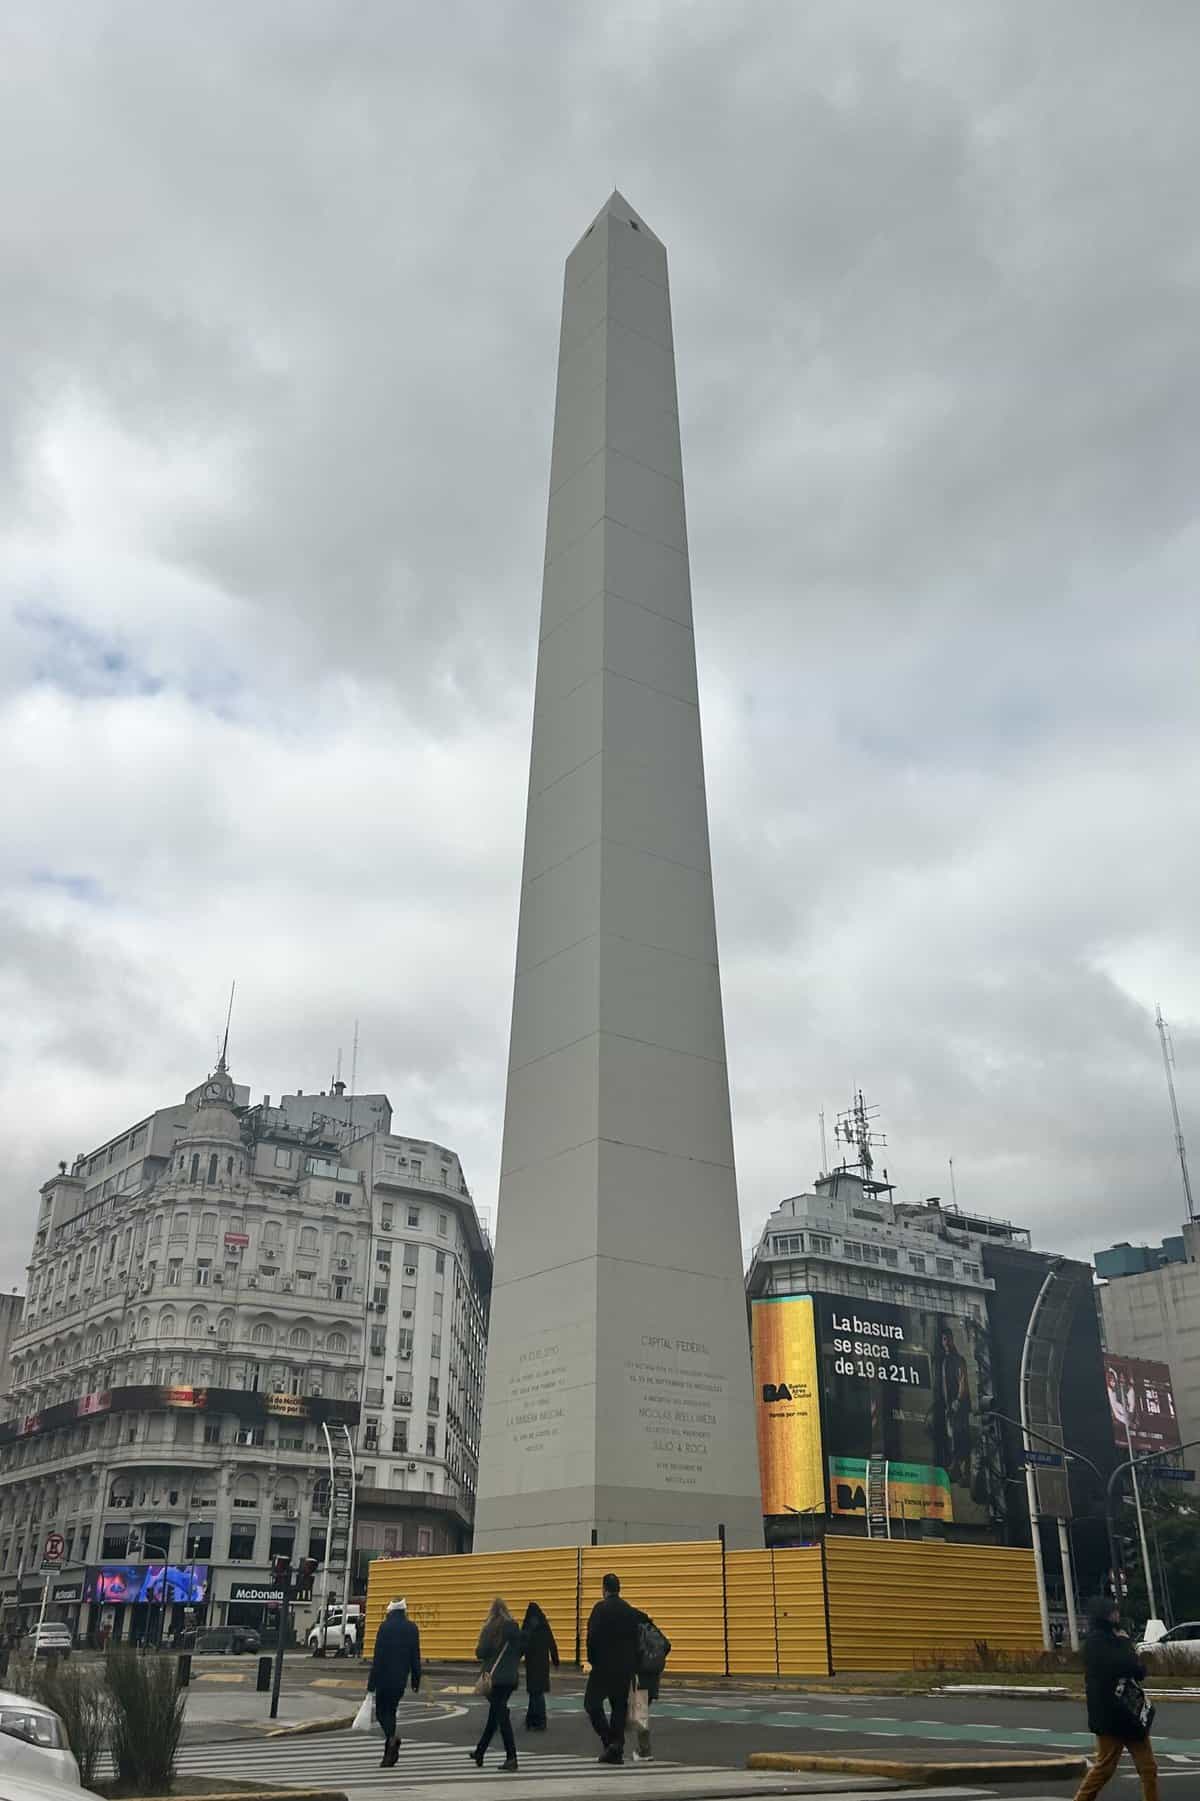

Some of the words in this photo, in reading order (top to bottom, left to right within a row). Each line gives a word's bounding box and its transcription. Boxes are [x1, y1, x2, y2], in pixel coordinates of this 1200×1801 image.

[832, 1313, 851, 1332] La
[853, 1315, 904, 1340] basura
[834, 1338, 852, 1353] se
[854, 1341, 890, 1359] saca
[835, 1357, 854, 1375] de
[857, 1361, 875, 1378] 19
[878, 1366, 887, 1380] a
[889, 1365, 908, 1383] 21
[910, 1367, 920, 1384] h
[763, 1384, 792, 1402] BA
[236, 1589, 284, 1600] McDonald
